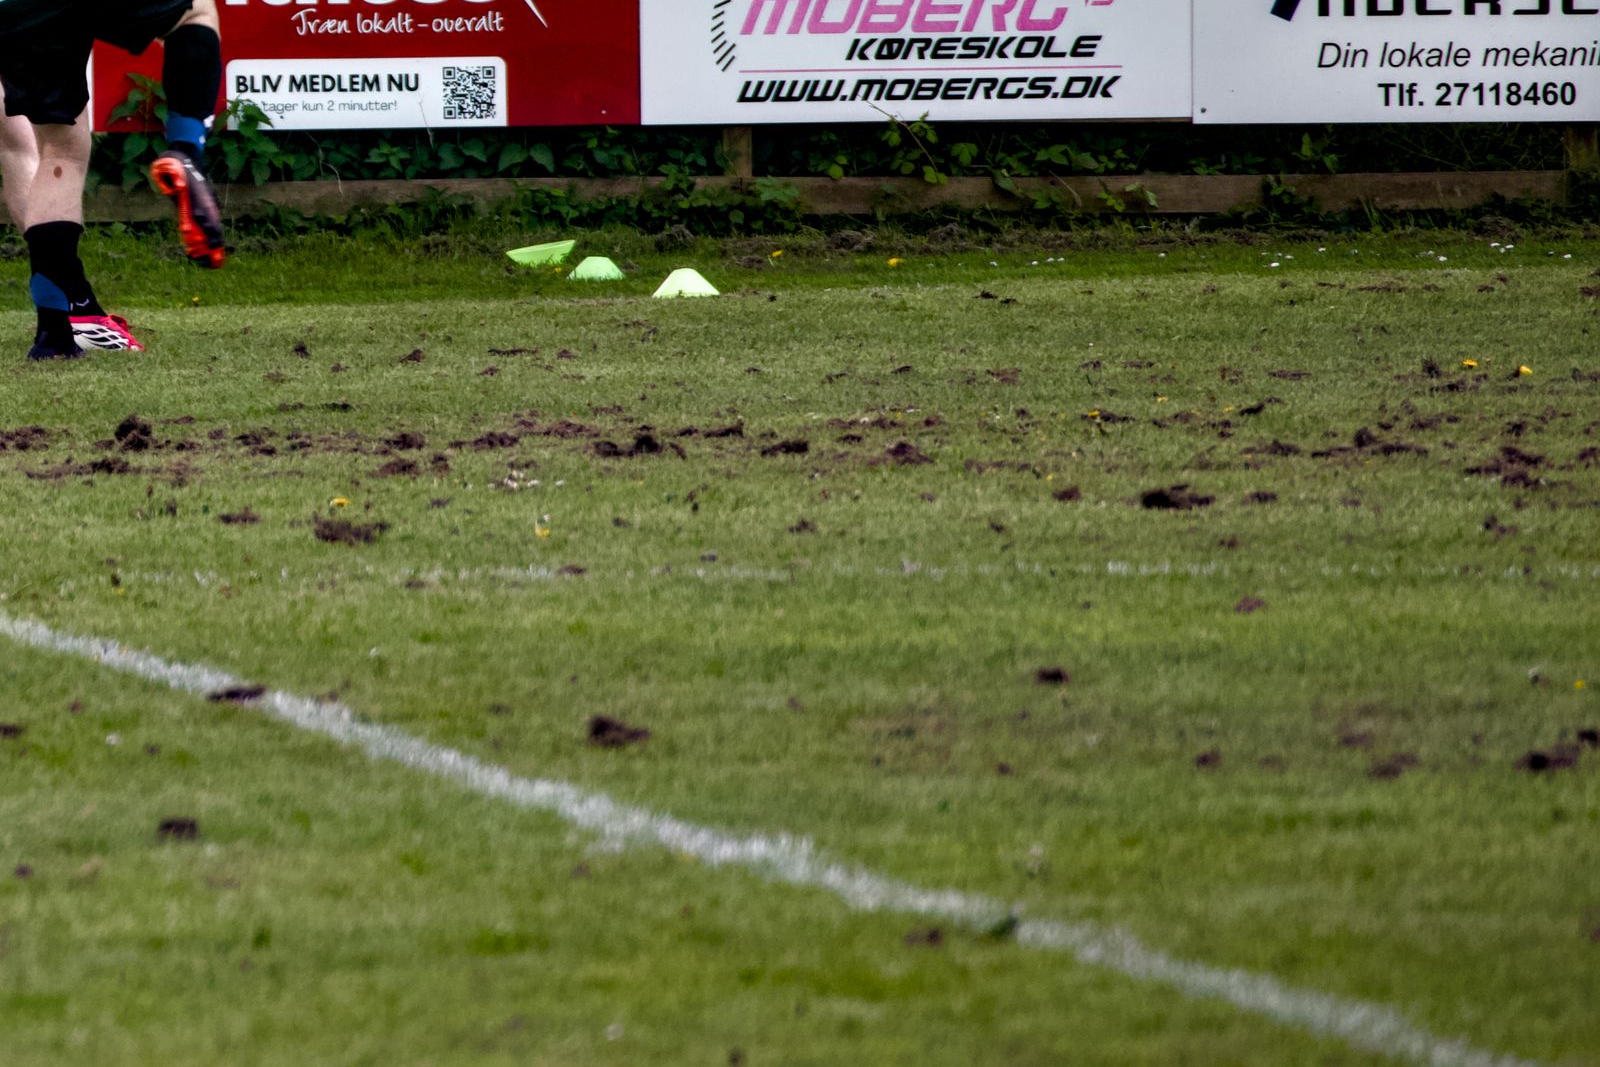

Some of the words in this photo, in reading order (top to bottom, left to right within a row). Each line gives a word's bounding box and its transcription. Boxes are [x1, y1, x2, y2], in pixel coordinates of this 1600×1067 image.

[356, 11, 413, 33] lokalt
[431, 10, 505, 33] overalt
[845, 35, 1102, 60] KØRESKOLE
[1317, 42, 1369, 68] Din
[1379, 41, 1472, 68] lokale
[1481, 40, 1600, 67] mekani
[236, 75, 283, 93] BLIV
[288, 74, 381, 92] MEDLEM
[386, 73, 420, 92] NU
[736, 75, 1122, 103] WWW.MOBERGS.DK
[1376, 82, 1426, 106] Tlf.
[1434, 81, 1577, 106] 27118460
[262, 101, 298, 114] tager
[302, 100, 324, 111] kun
[326, 100, 336, 112] 2
[338, 99, 398, 111] minutter!
